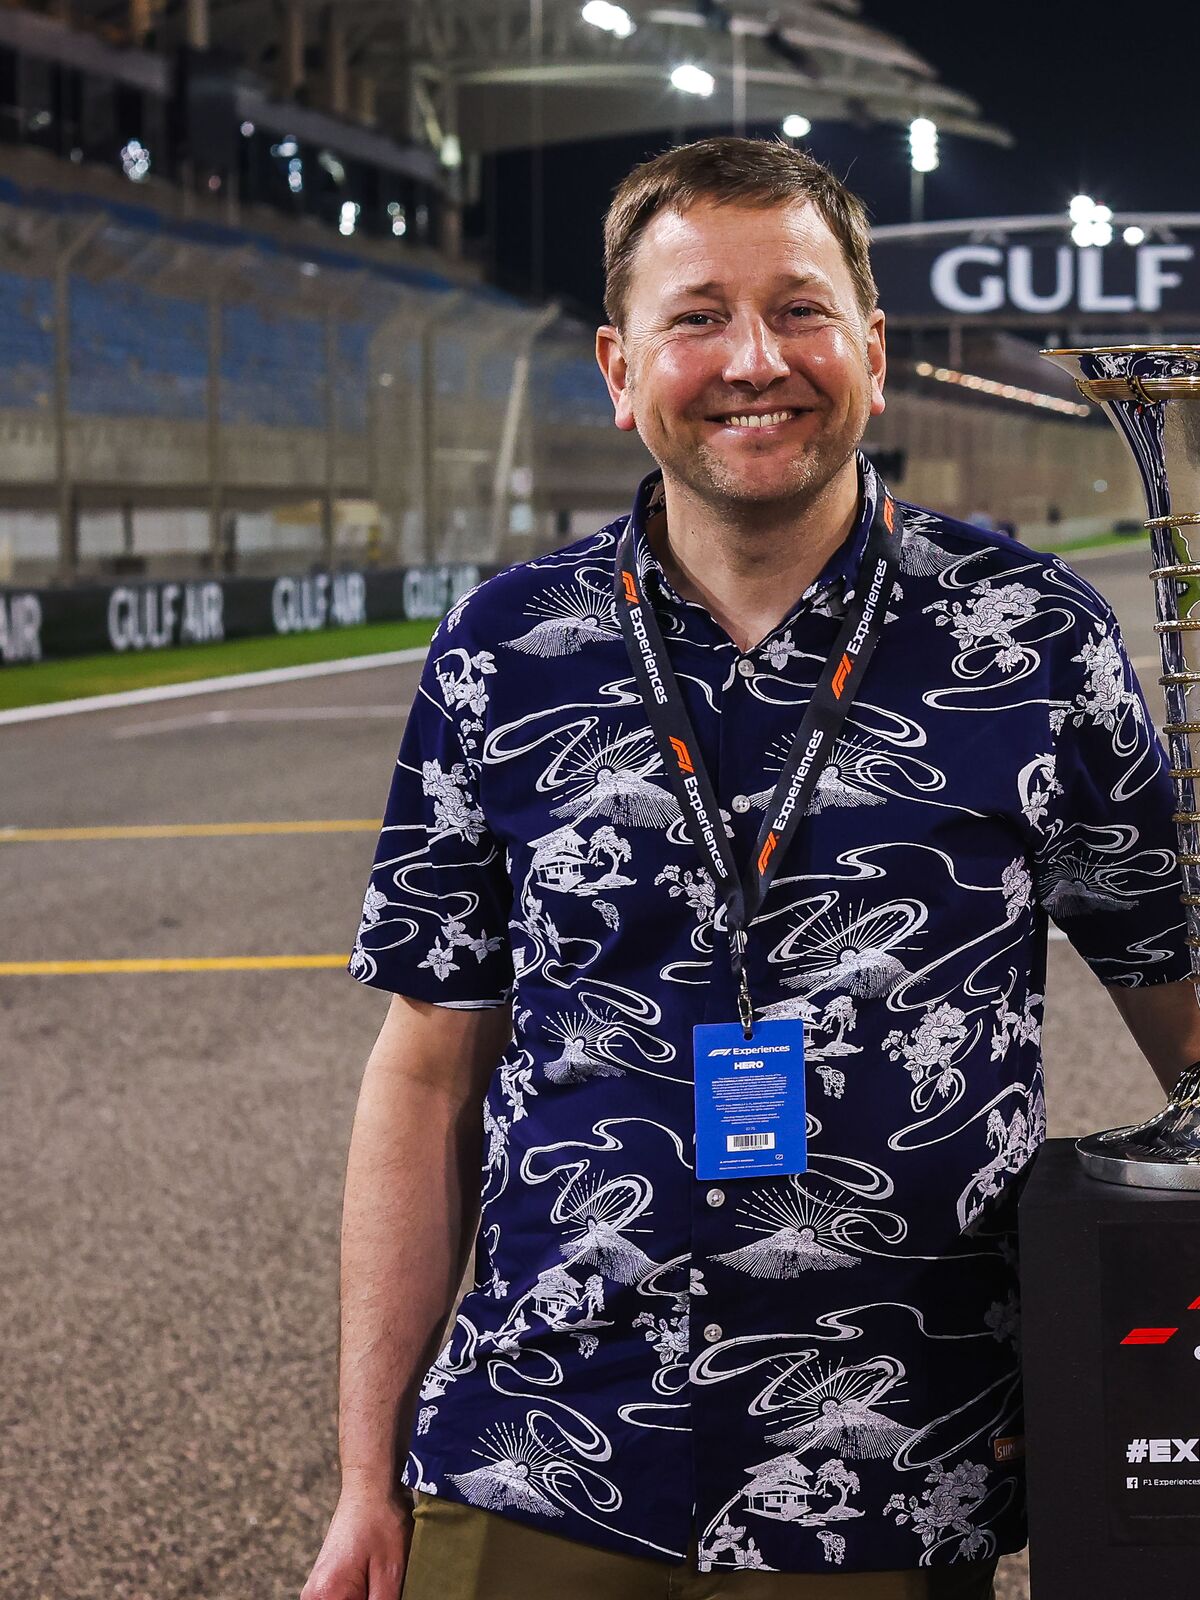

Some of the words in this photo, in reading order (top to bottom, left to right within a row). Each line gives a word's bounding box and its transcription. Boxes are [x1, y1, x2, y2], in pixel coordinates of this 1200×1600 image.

[930, 245, 1194, 313] GULF
[108, 587, 178, 652] GULF
[181, 582, 225, 642] AIR
[272, 576, 328, 635] GULF
[330, 572, 367, 625] AIR
[831, 652, 852, 700] F1
[846, 557, 888, 656] Experiences
[629, 605, 669, 706] Experiences
[669, 735, 695, 774] F1
[684, 775, 729, 880] Experiences
[757, 831, 777, 877] F1
[773, 728, 824, 832] Experiences
[732, 1045, 790, 1056] Experiences
[734, 1060, 764, 1070] HERO
